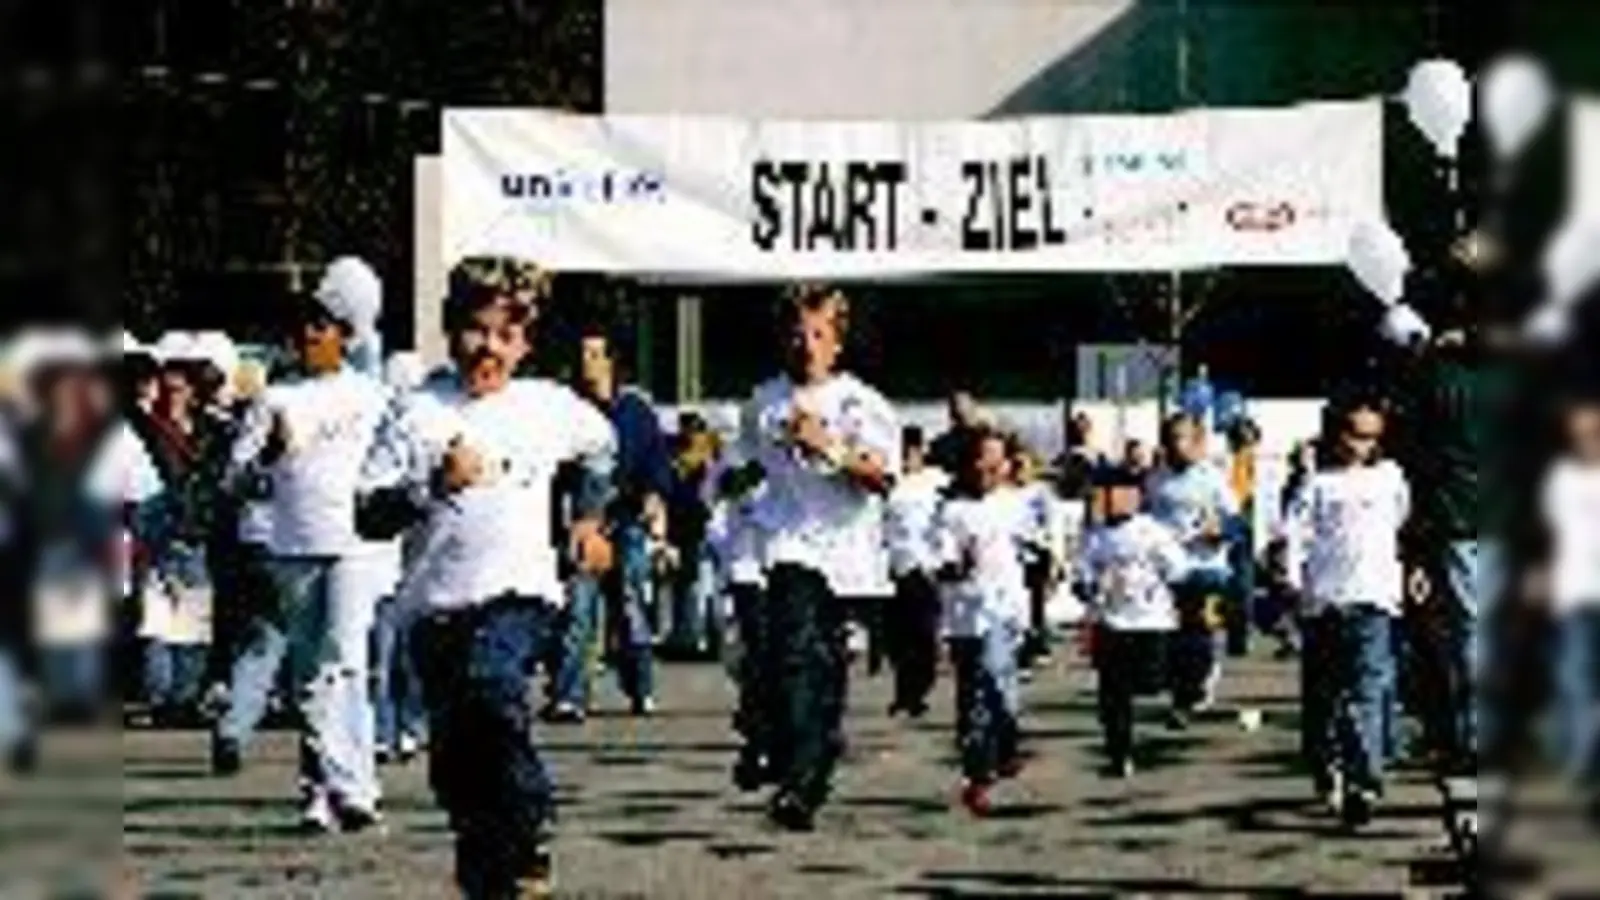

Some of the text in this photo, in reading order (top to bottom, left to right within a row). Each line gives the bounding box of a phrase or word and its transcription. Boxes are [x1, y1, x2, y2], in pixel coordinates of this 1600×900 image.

[501, 168, 616, 204] unif
[751, 160, 908, 252] START
[961, 155, 1067, 252] ZIEL
